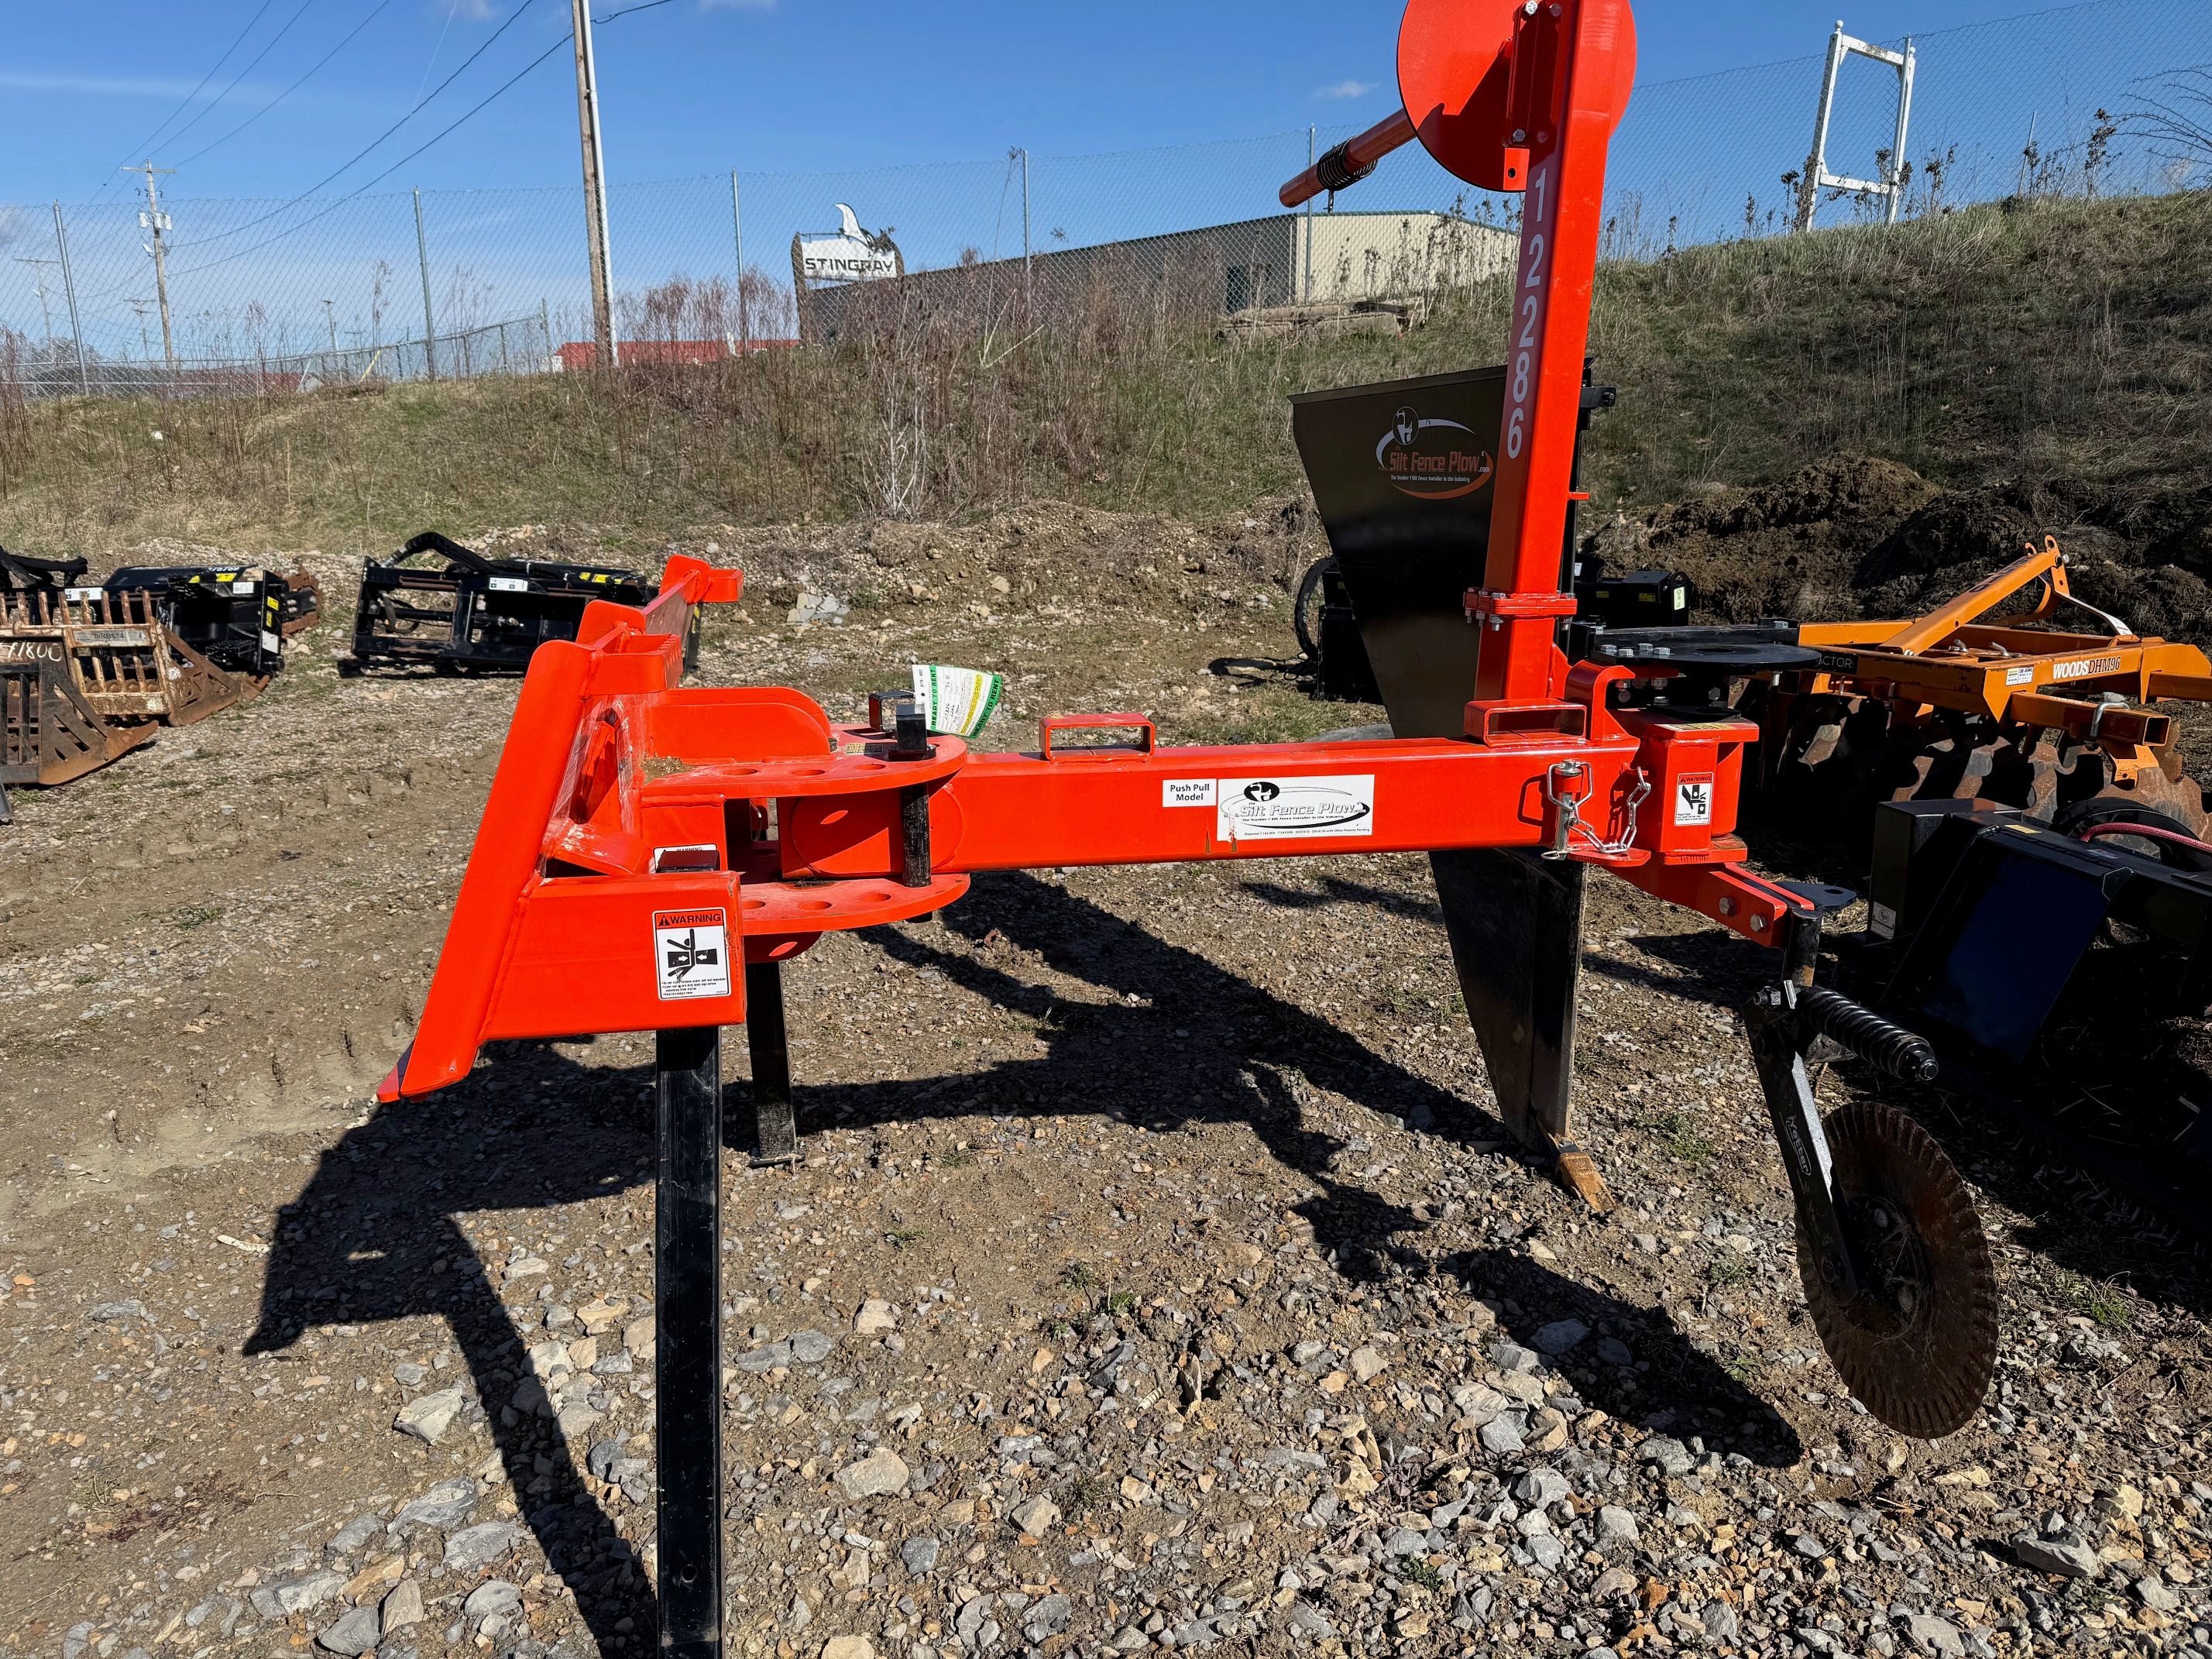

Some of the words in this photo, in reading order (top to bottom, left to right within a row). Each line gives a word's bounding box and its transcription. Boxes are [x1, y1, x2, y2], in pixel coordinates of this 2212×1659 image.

[805, 257, 893, 272] STINGRAY
[1507, 168, 1547, 459] 12286
[1389, 452, 1408, 471] Silt
[1411, 452, 1445, 472] Fence
[1449, 451, 1479, 472] Plow
[2053, 661, 2089, 679] WOODS
[2089, 656, 2121, 674] DHM96
[931, 689, 937, 698] TO
[972, 713, 988, 737] READY
[985, 702, 994, 711] TO
[990, 678, 999, 700] RENT
[1170, 785, 1191, 793] Push
[1240, 804, 1267, 817] Silt
[1269, 803, 1315, 816] Fence
[1318, 802, 1355, 814] Plow
[670, 914, 721, 924] WARNING
